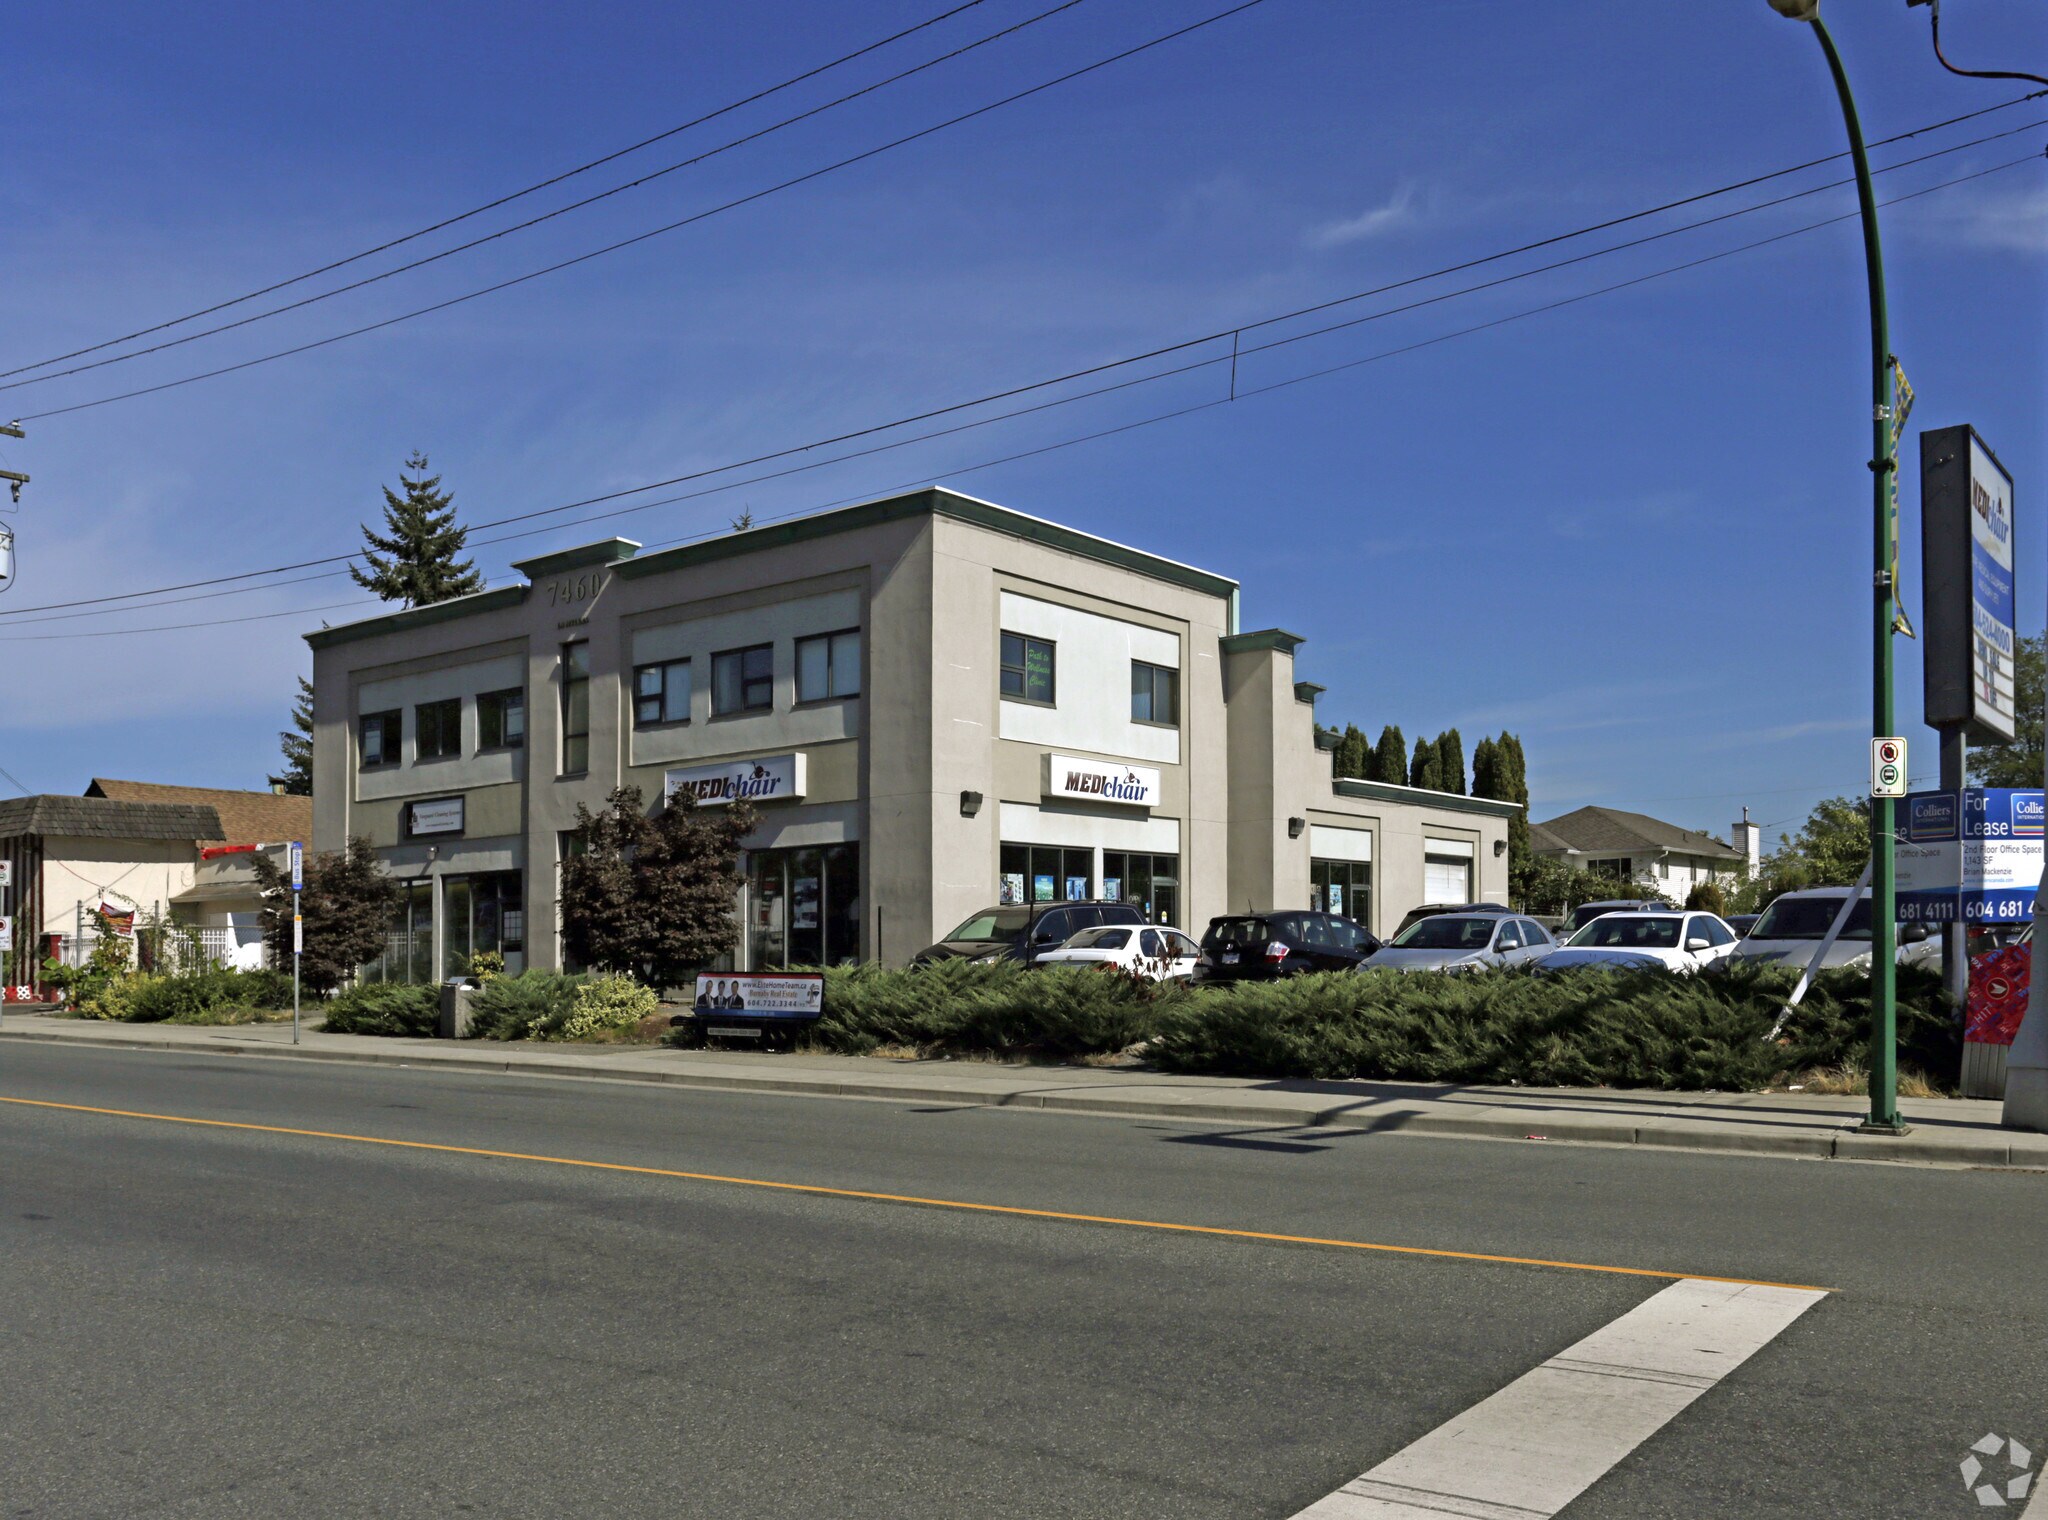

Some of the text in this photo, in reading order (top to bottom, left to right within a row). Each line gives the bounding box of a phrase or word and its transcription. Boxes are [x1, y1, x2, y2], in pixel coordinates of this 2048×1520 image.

[547, 572, 601, 607] 7460
[1065, 771, 1148, 801] MEDIchair
[1965, 793, 1989, 811] For
[2016, 801, 2044, 814] Collie
[1915, 804, 1951, 818] Colliers
[1965, 817, 2008, 836] Lease
[1964, 844, 2042, 855] 2nd Floor Office Space
[1964, 856, 1994, 866] 1,143 SF
[1982, 867, 2012, 875] Mackenzie
[1900, 902, 1953, 919] 681 4111
[1966, 901, 1994, 917] 604
[1999, 900, 2023, 918] 681
[742, 981, 807, 990] www.EliteHomeTeam.ca
